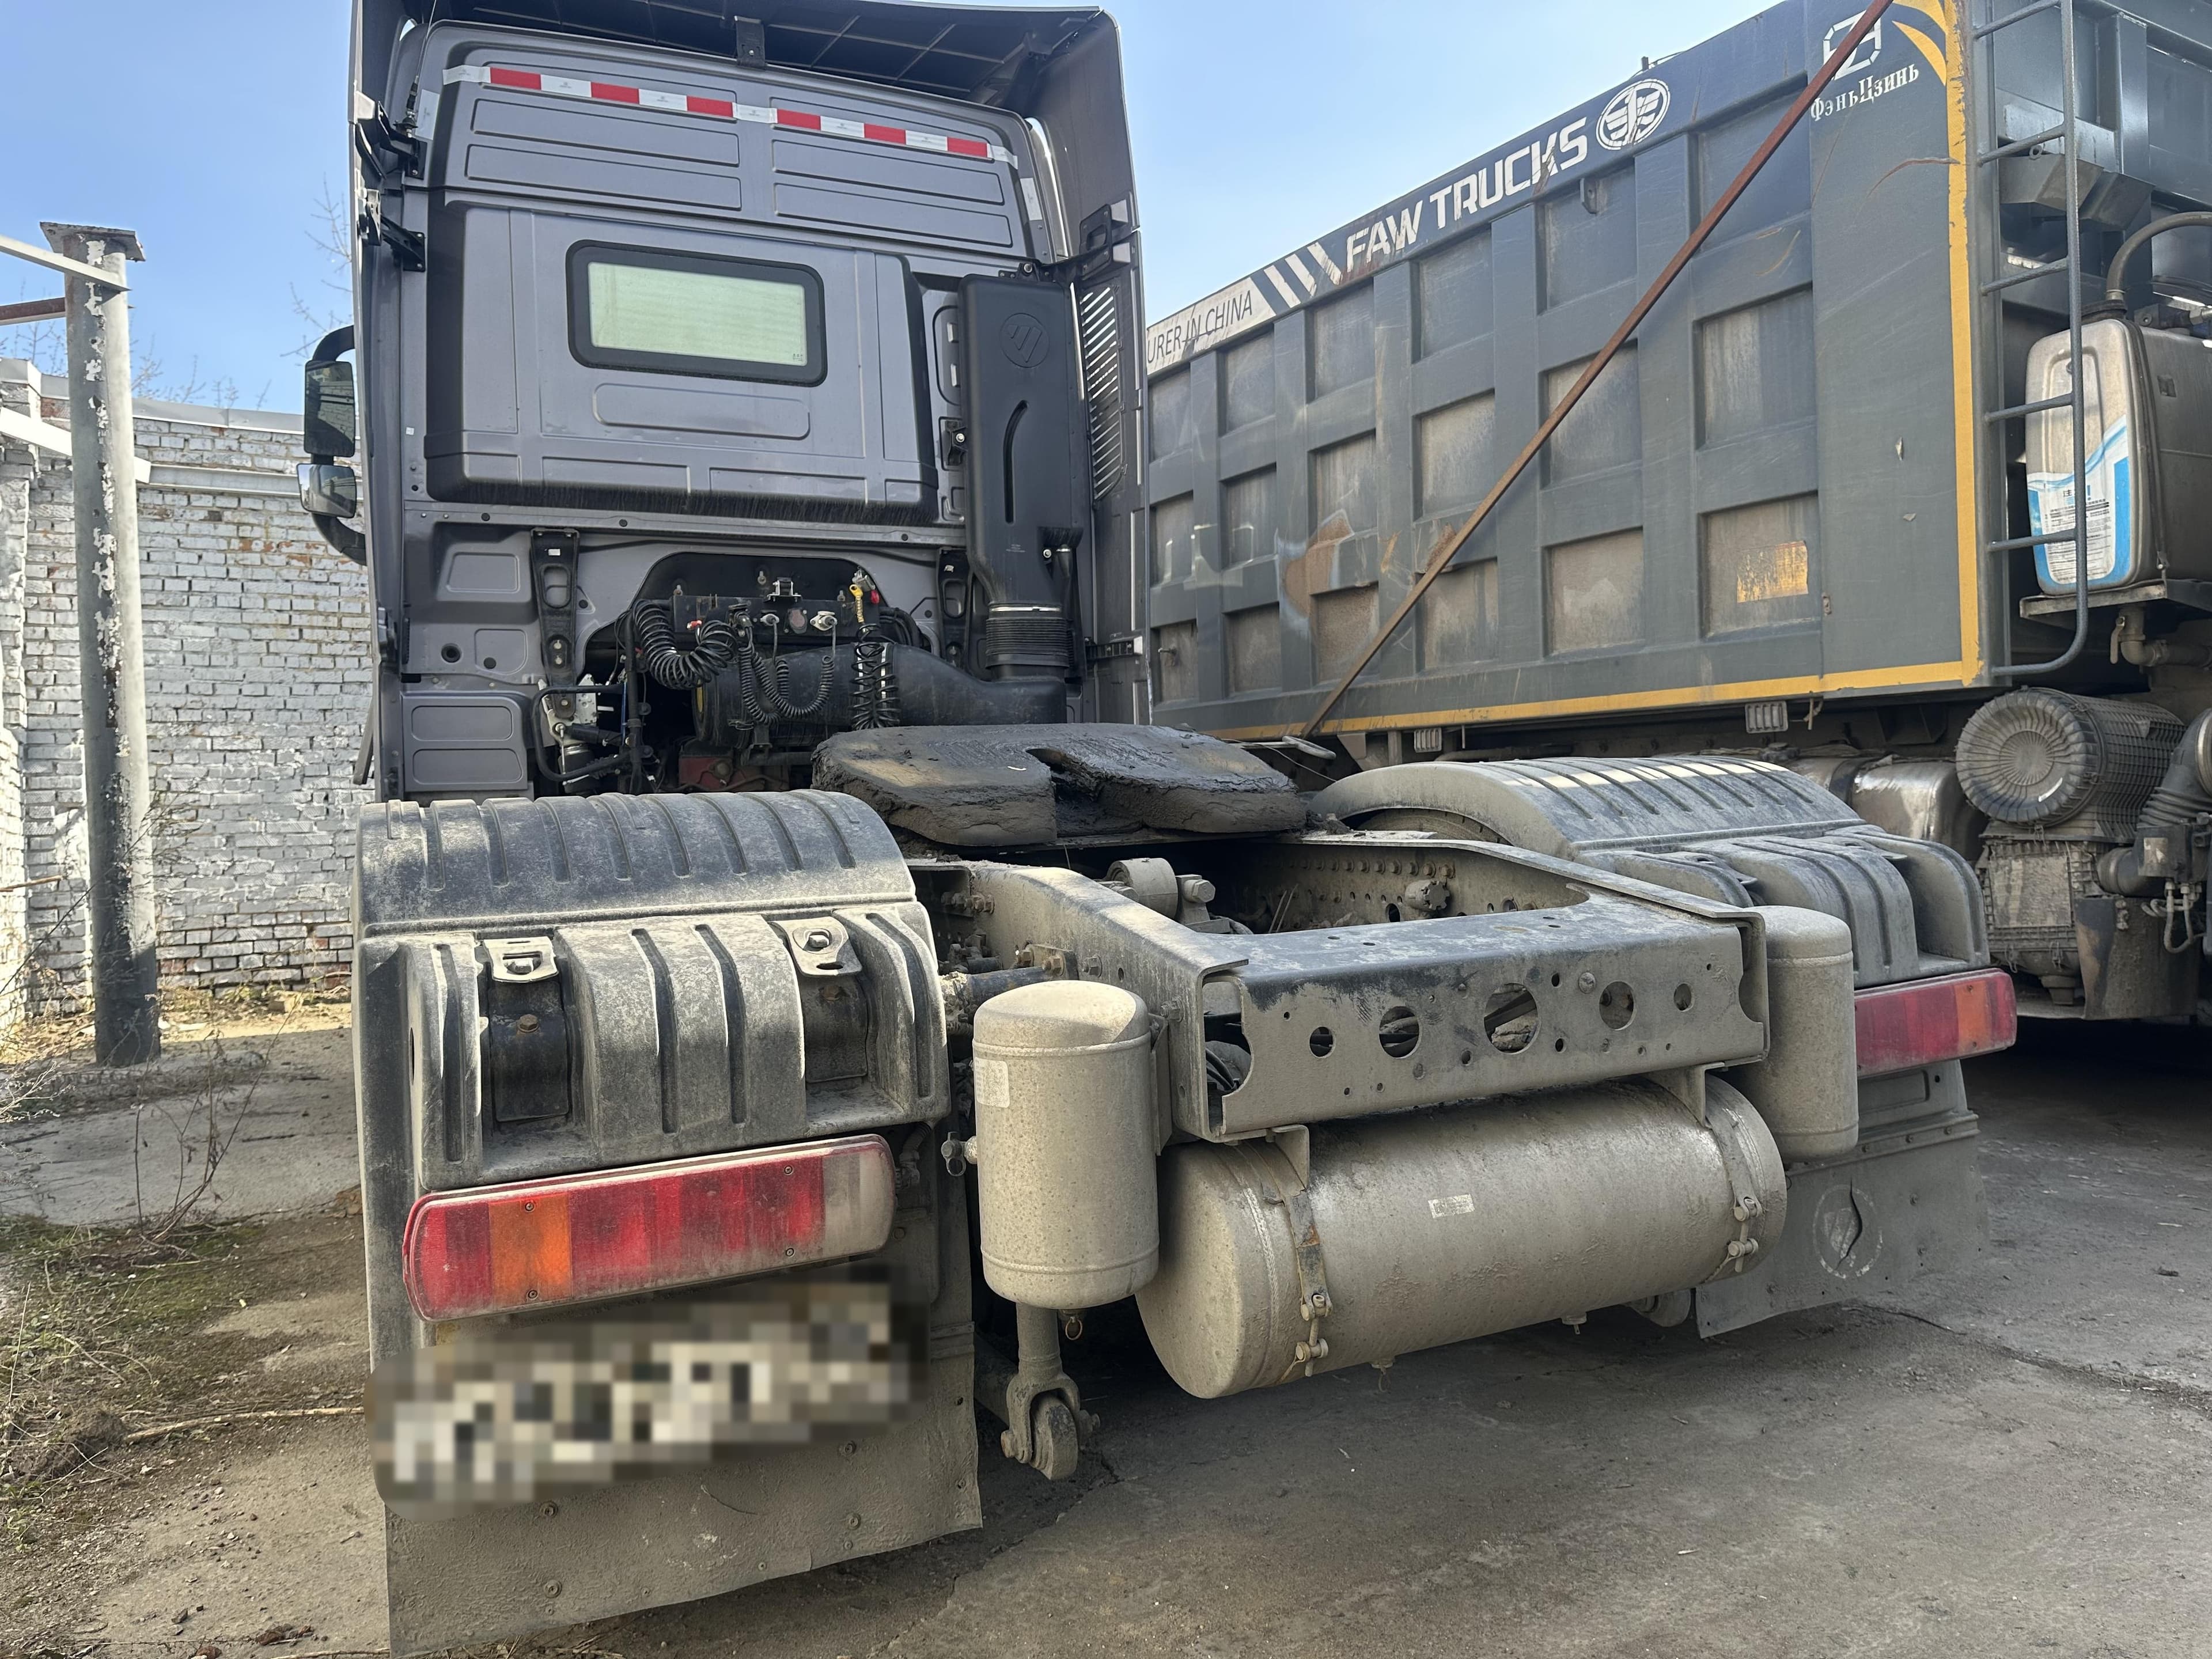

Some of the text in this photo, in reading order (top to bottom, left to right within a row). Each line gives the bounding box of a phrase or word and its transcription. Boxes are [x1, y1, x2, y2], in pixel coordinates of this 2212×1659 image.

[1810, 63, 1919, 121] ФэньЦзинь
[1347, 117, 1588, 272] FAW TRUCKS
[1184, 315, 1201, 349] IN
[1206, 290, 1252, 335] CHINA
